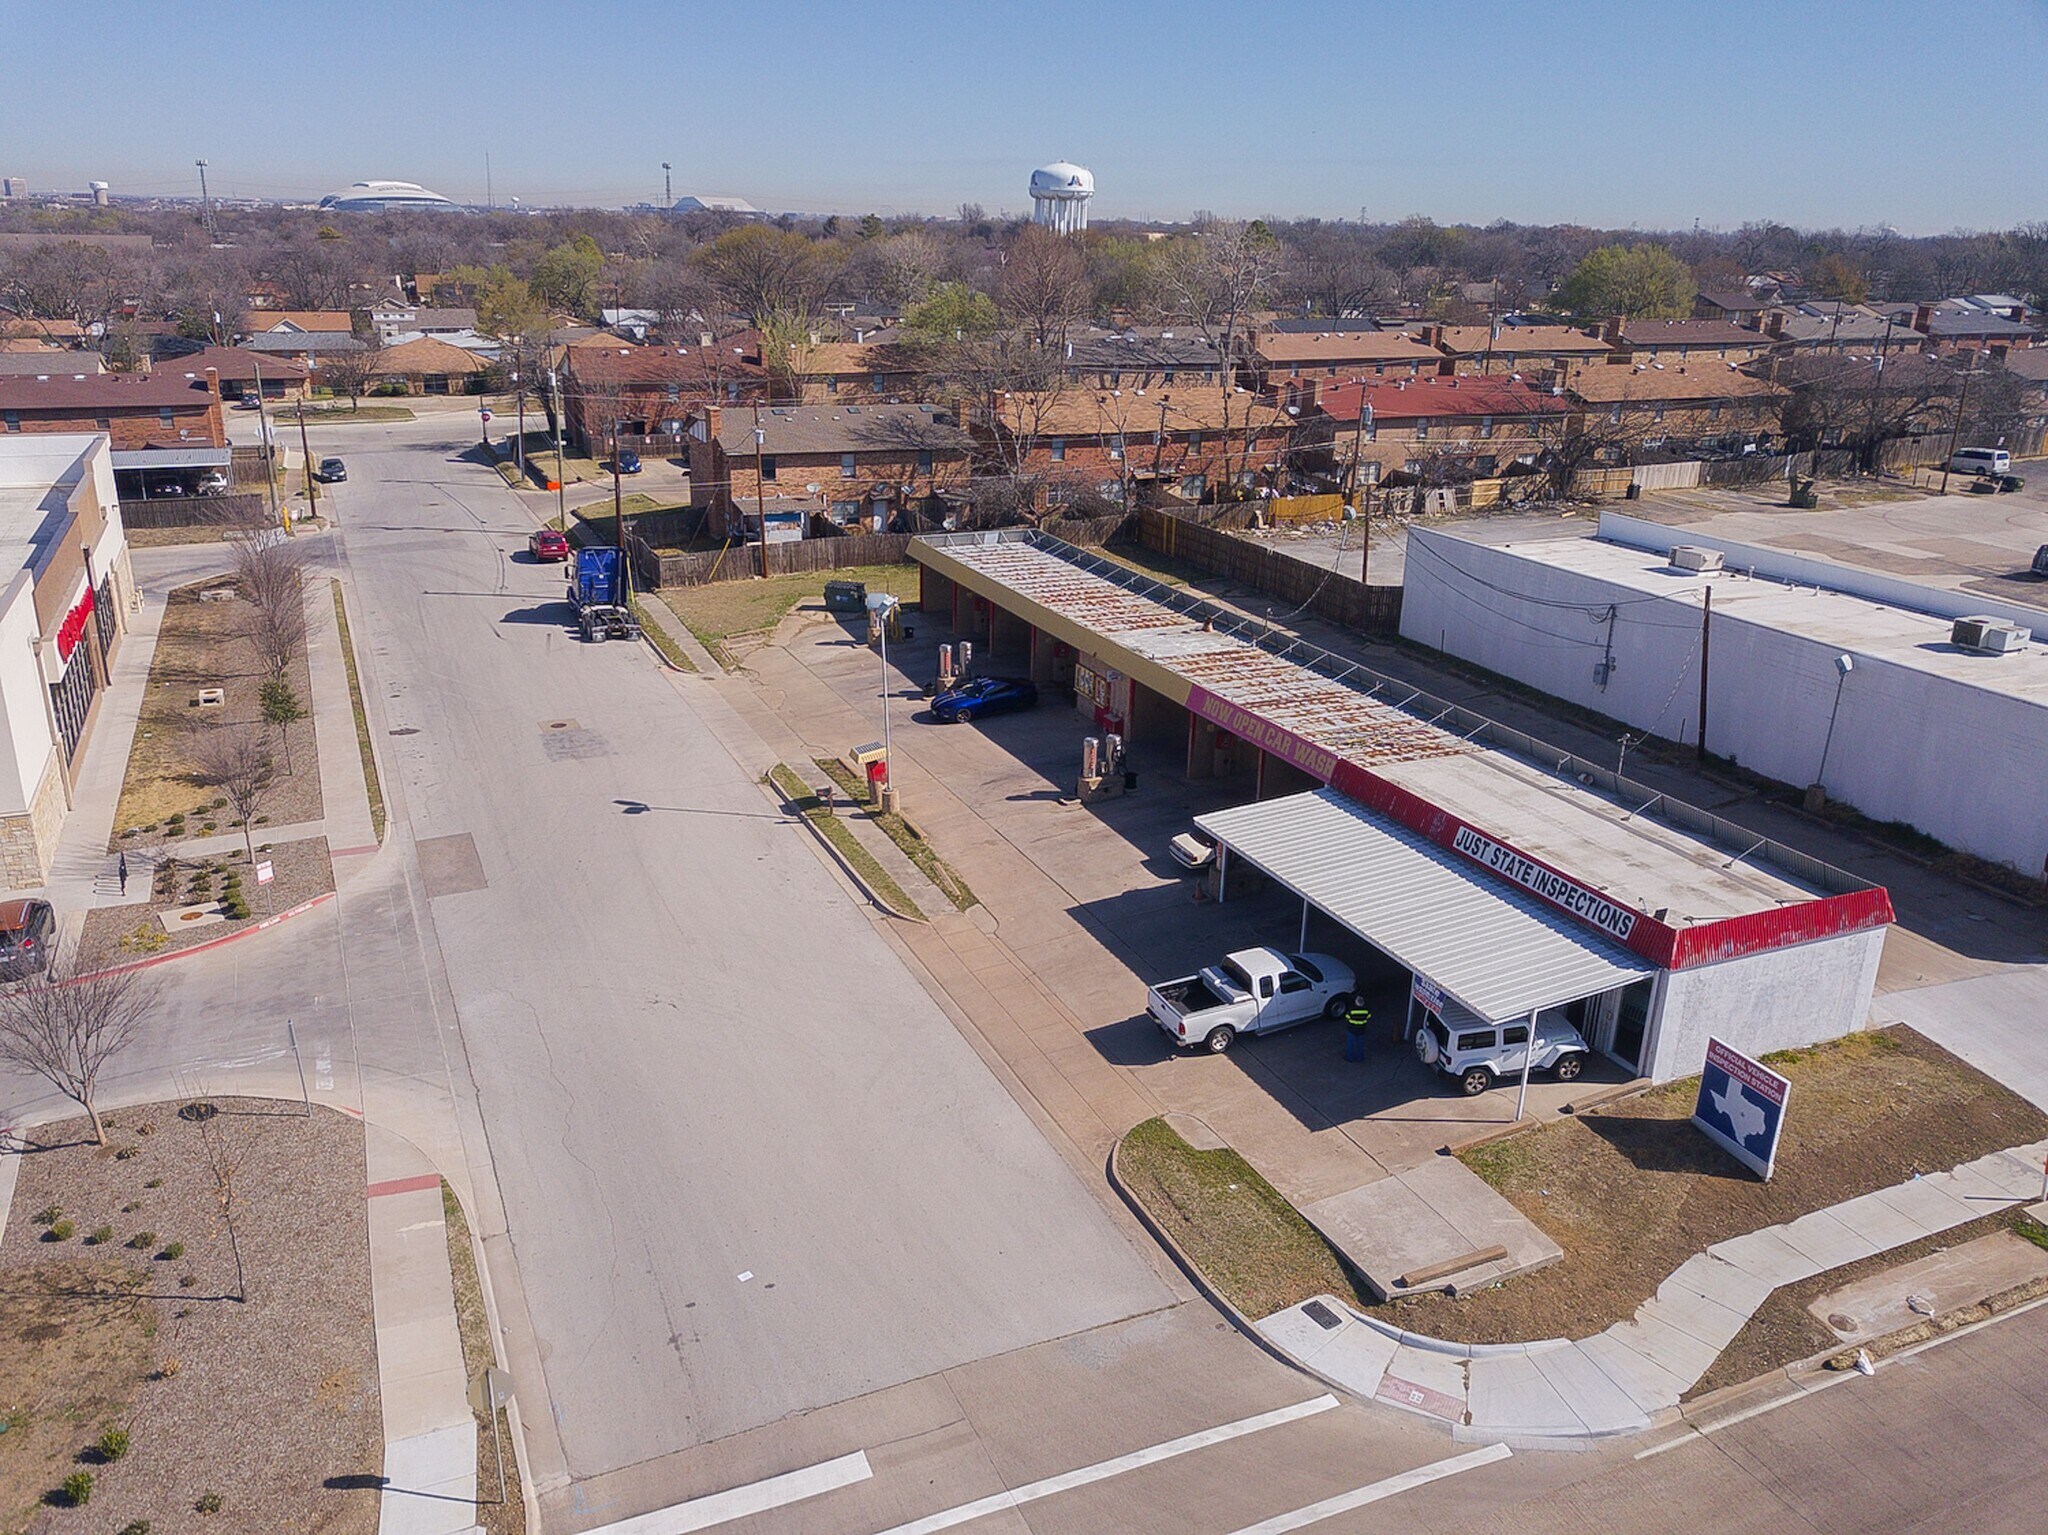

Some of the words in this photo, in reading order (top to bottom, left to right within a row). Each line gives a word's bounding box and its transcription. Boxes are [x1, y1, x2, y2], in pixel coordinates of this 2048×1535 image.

[1202, 696, 1234, 723] NOW
[1232, 712, 1265, 741] OPEN
[1264, 728, 1292, 756] CAR
[1293, 742, 1338, 779] WASH
[1455, 830, 1492, 860] JUST
[1489, 847, 1534, 885] STATE
[1533, 869, 1634, 937] INSPECTIONS
[1708, 1051, 1751, 1082] INSPECTION
[1750, 1077, 1783, 1102] STATION
[1715, 1045, 1747, 1071] OFFICIAL
[1747, 1065, 1780, 1089] VEHICLE
